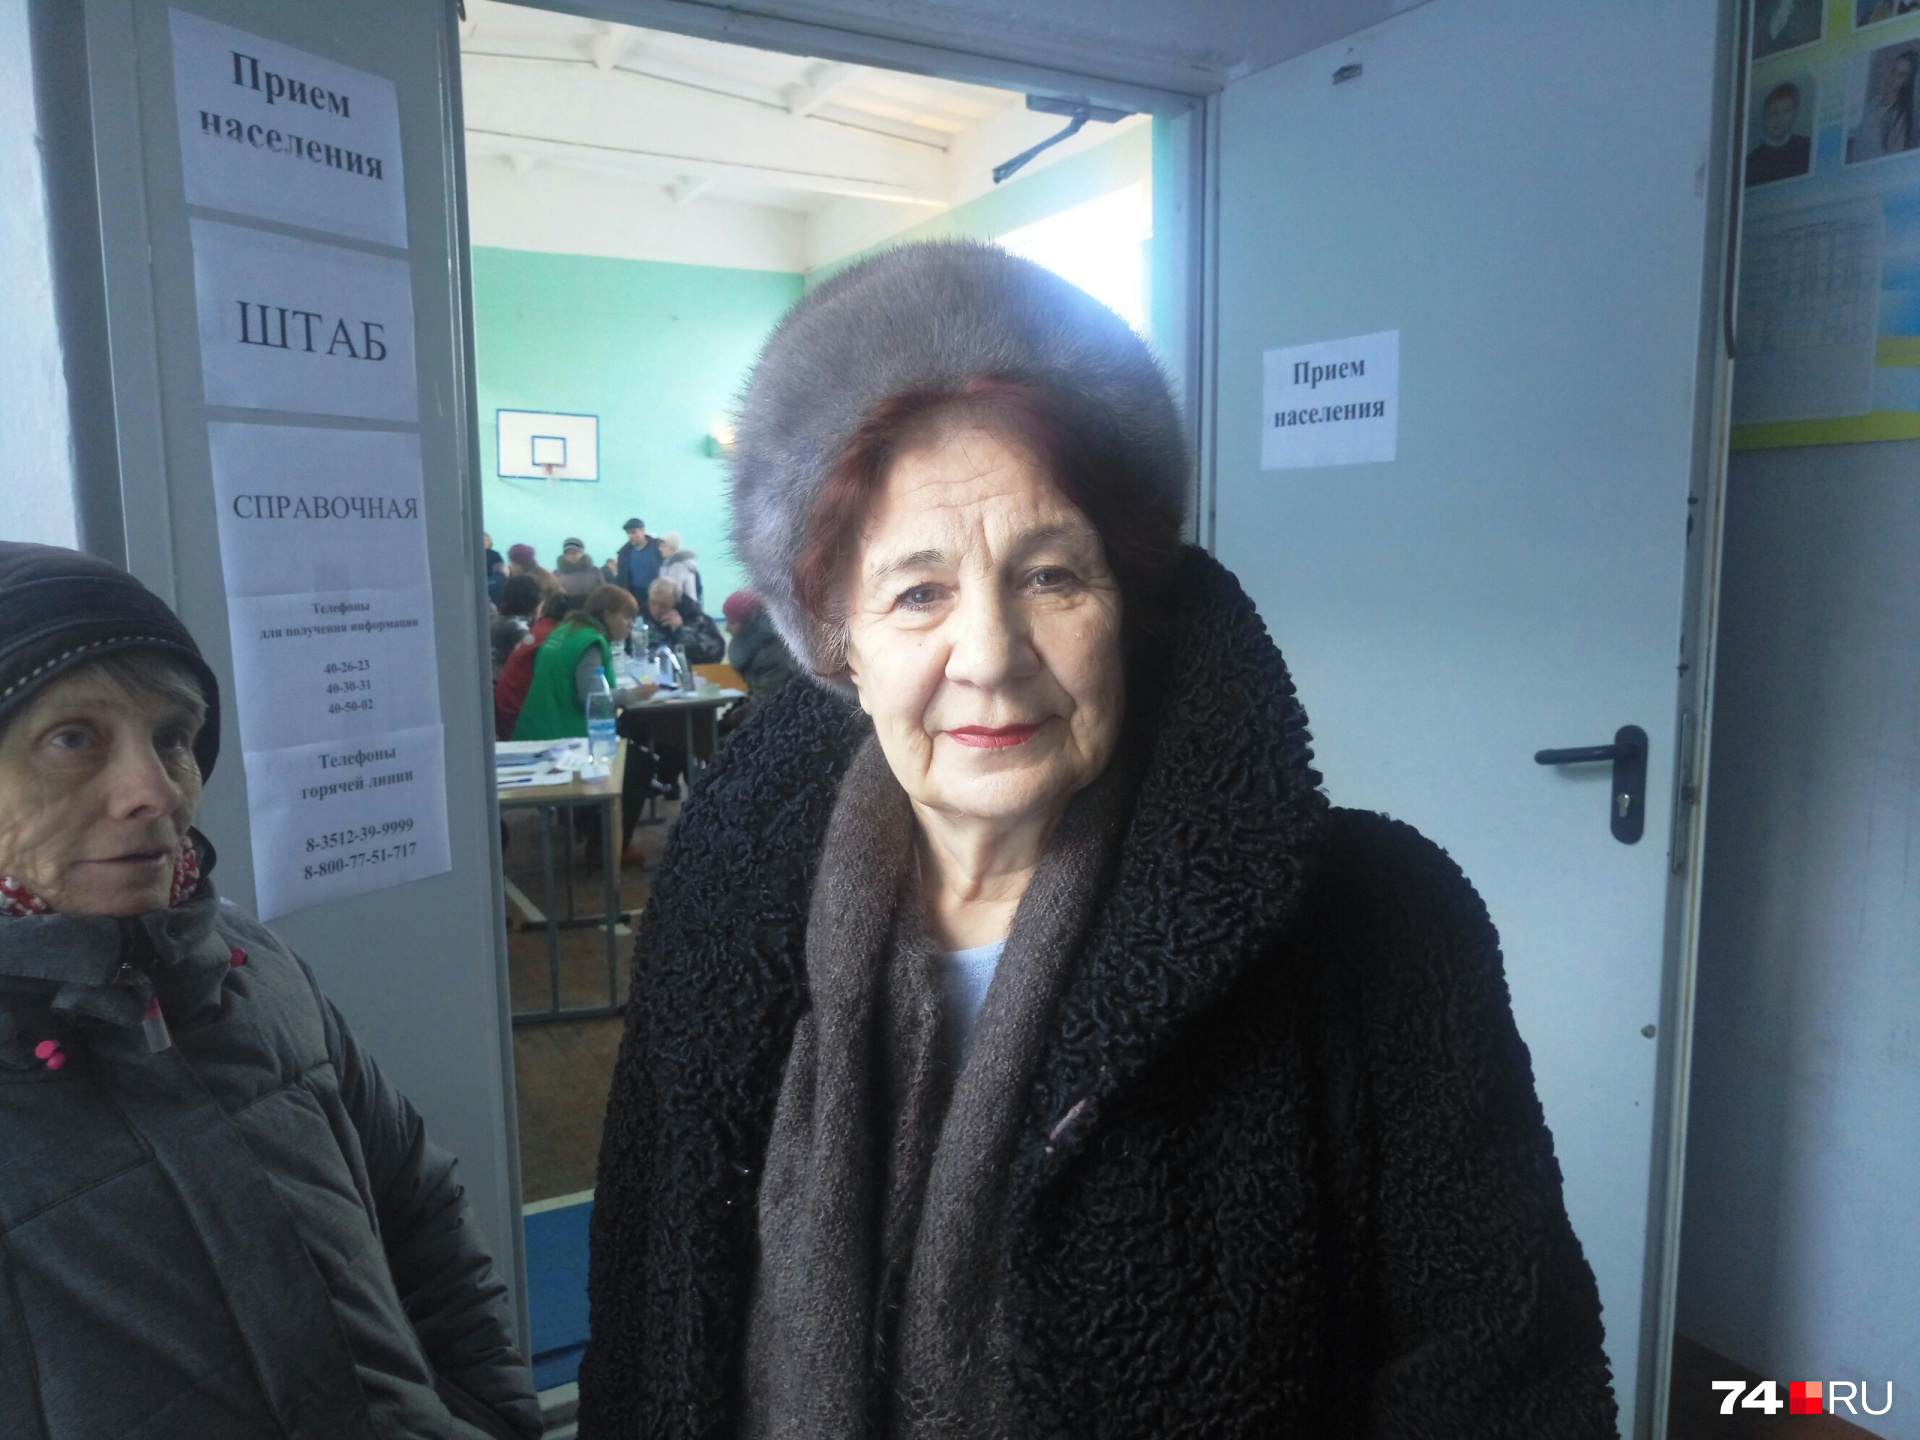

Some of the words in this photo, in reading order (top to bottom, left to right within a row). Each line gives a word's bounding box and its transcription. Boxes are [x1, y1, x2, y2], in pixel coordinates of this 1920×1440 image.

[230, 50, 351, 118] Прием
[199, 109, 383, 180] населения
[237, 300, 387, 362] ШТАБ
[1294, 359, 1365, 389] Прием
[1274, 400, 1385, 428] населения
[233, 494, 418, 520] СПРАВОЧНАЯ
[312, 602, 370, 615] Телефоны
[260, 629, 282, 640] для
[286, 624, 347, 638] получения
[351, 619, 419, 633] информации
[324, 660, 370, 674] 40-26-23
[326, 679, 371, 694] 40-30-31
[328, 699, 374, 714] 40-50-02
[318, 748, 396, 769] Телефоны
[302, 776, 364, 801] горячей
[368, 771, 413, 788] линии
[306, 818, 414, 853] 8-3512-39-9999
[304, 842, 417, 880] 8-800-77-51-717
